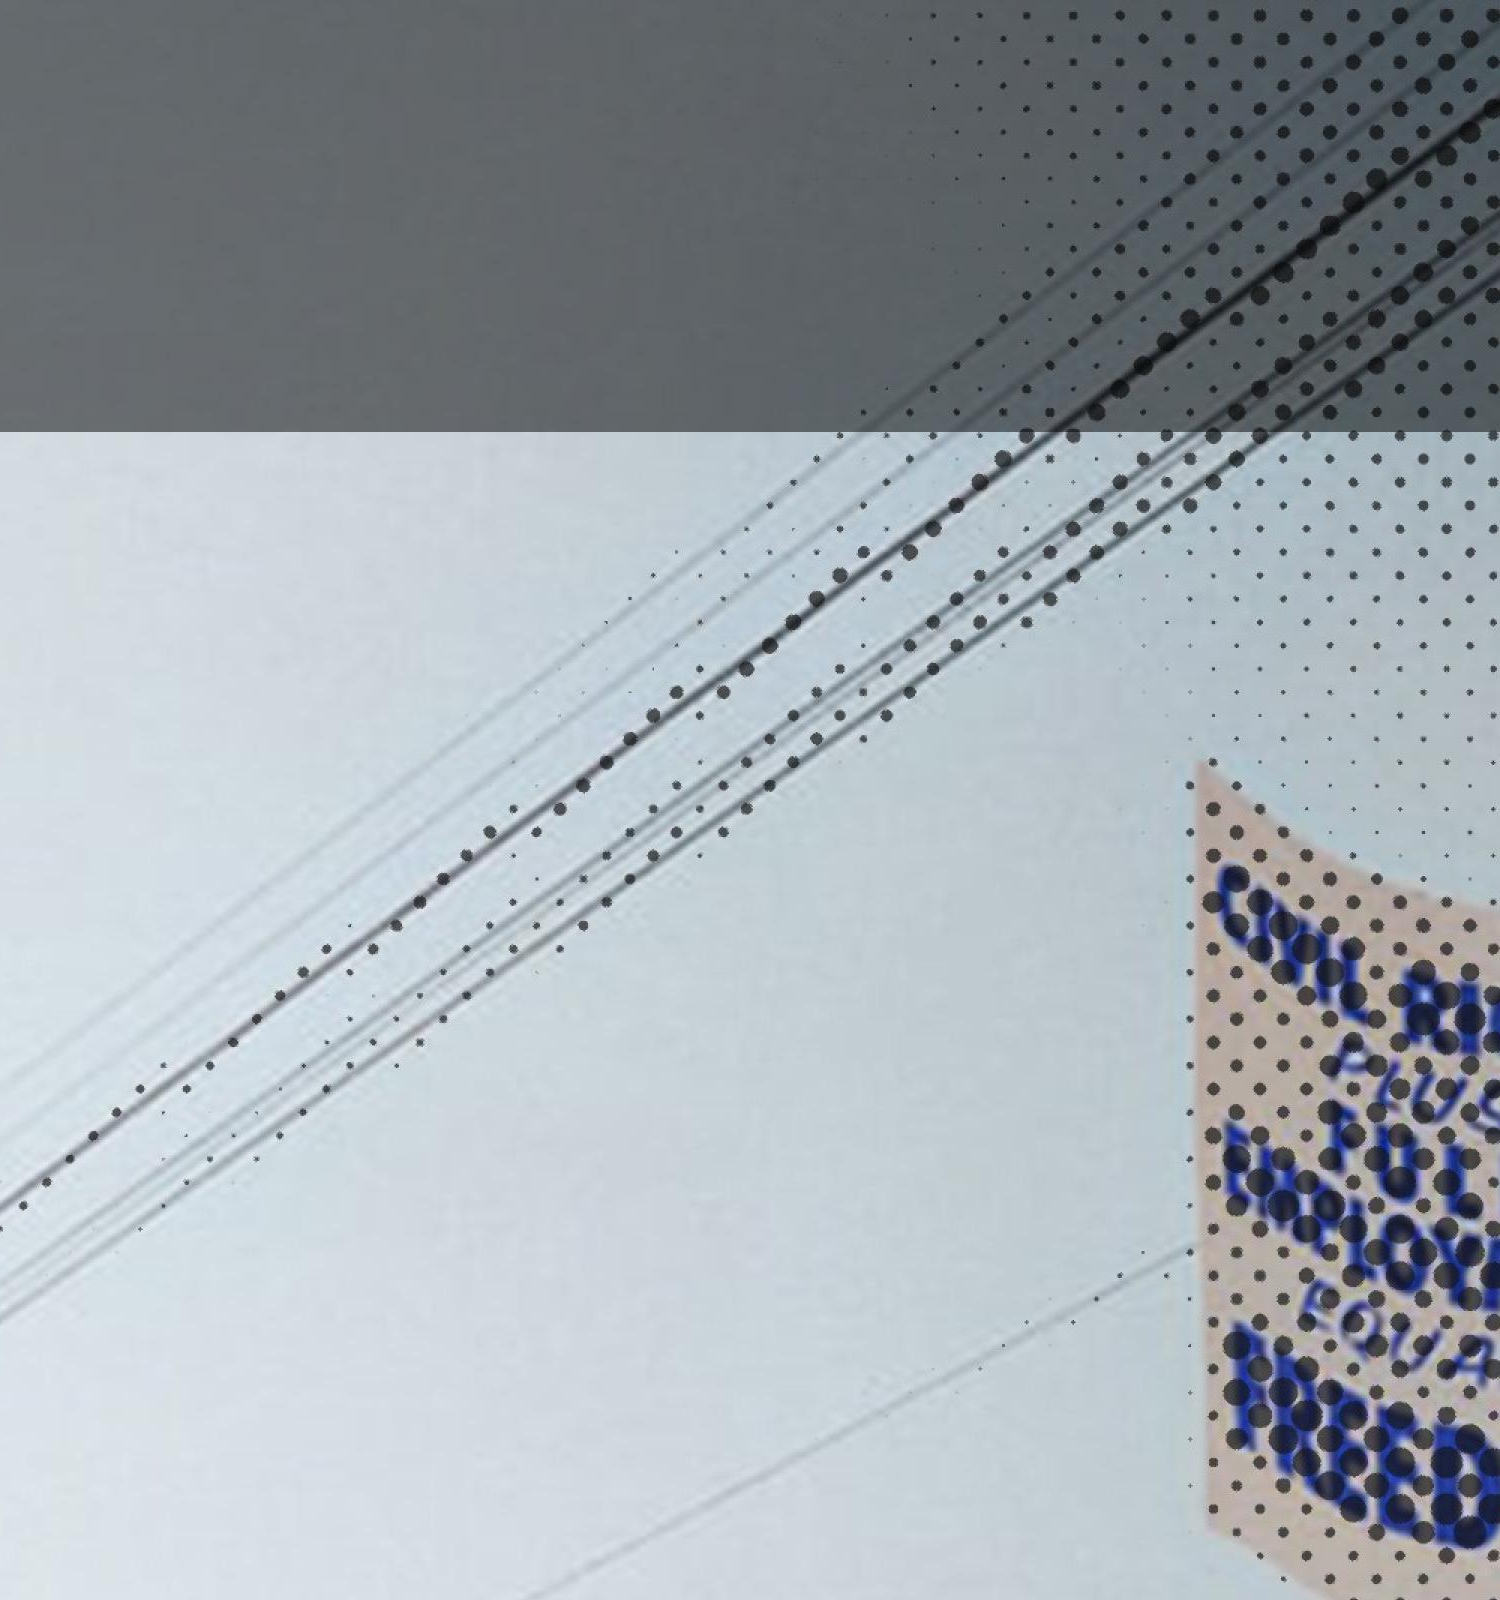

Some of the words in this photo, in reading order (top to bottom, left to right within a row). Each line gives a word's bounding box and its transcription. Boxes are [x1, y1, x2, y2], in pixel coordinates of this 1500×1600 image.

[1214, 862, 1373, 1026] CIVIL
[1402, 966, 1500, 1055] RI
[1224, 1120, 1500, 1312] EMPLOY
[1298, 1278, 1500, 1390] EQUA
[1230, 1320, 1500, 1548] FREED
